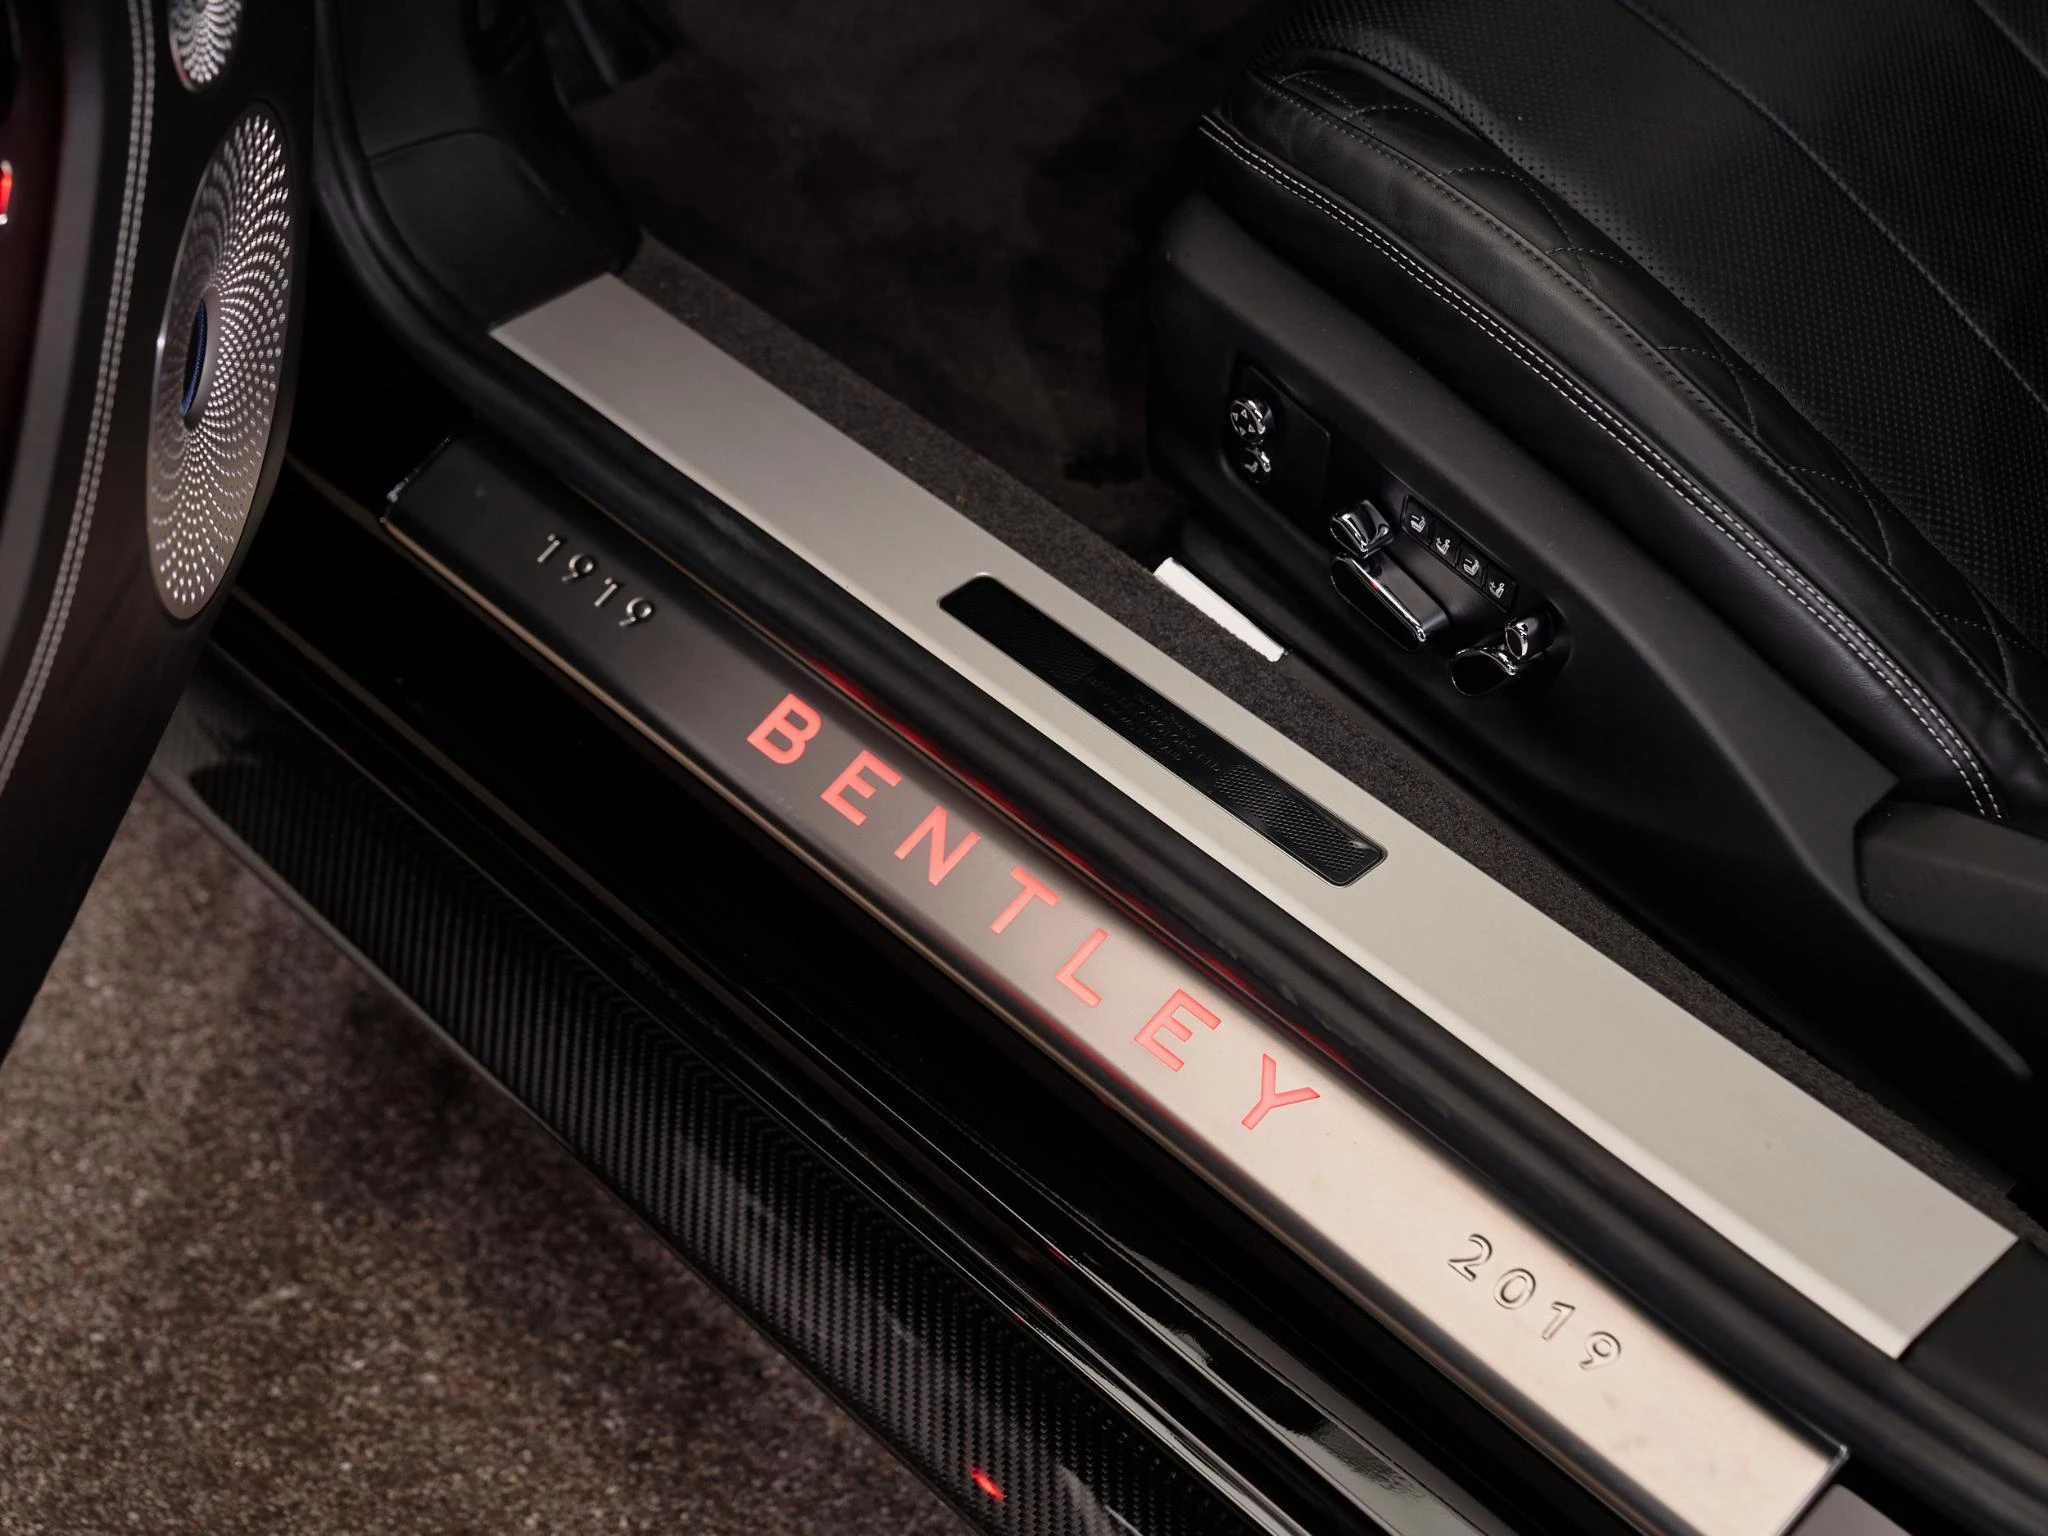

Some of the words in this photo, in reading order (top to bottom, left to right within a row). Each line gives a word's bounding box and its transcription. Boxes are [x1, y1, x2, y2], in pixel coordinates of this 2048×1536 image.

[537, 533, 654, 627] 1919
[746, 693, 1320, 1131] BENTLEY
[1447, 1233, 1622, 1371] 2019
